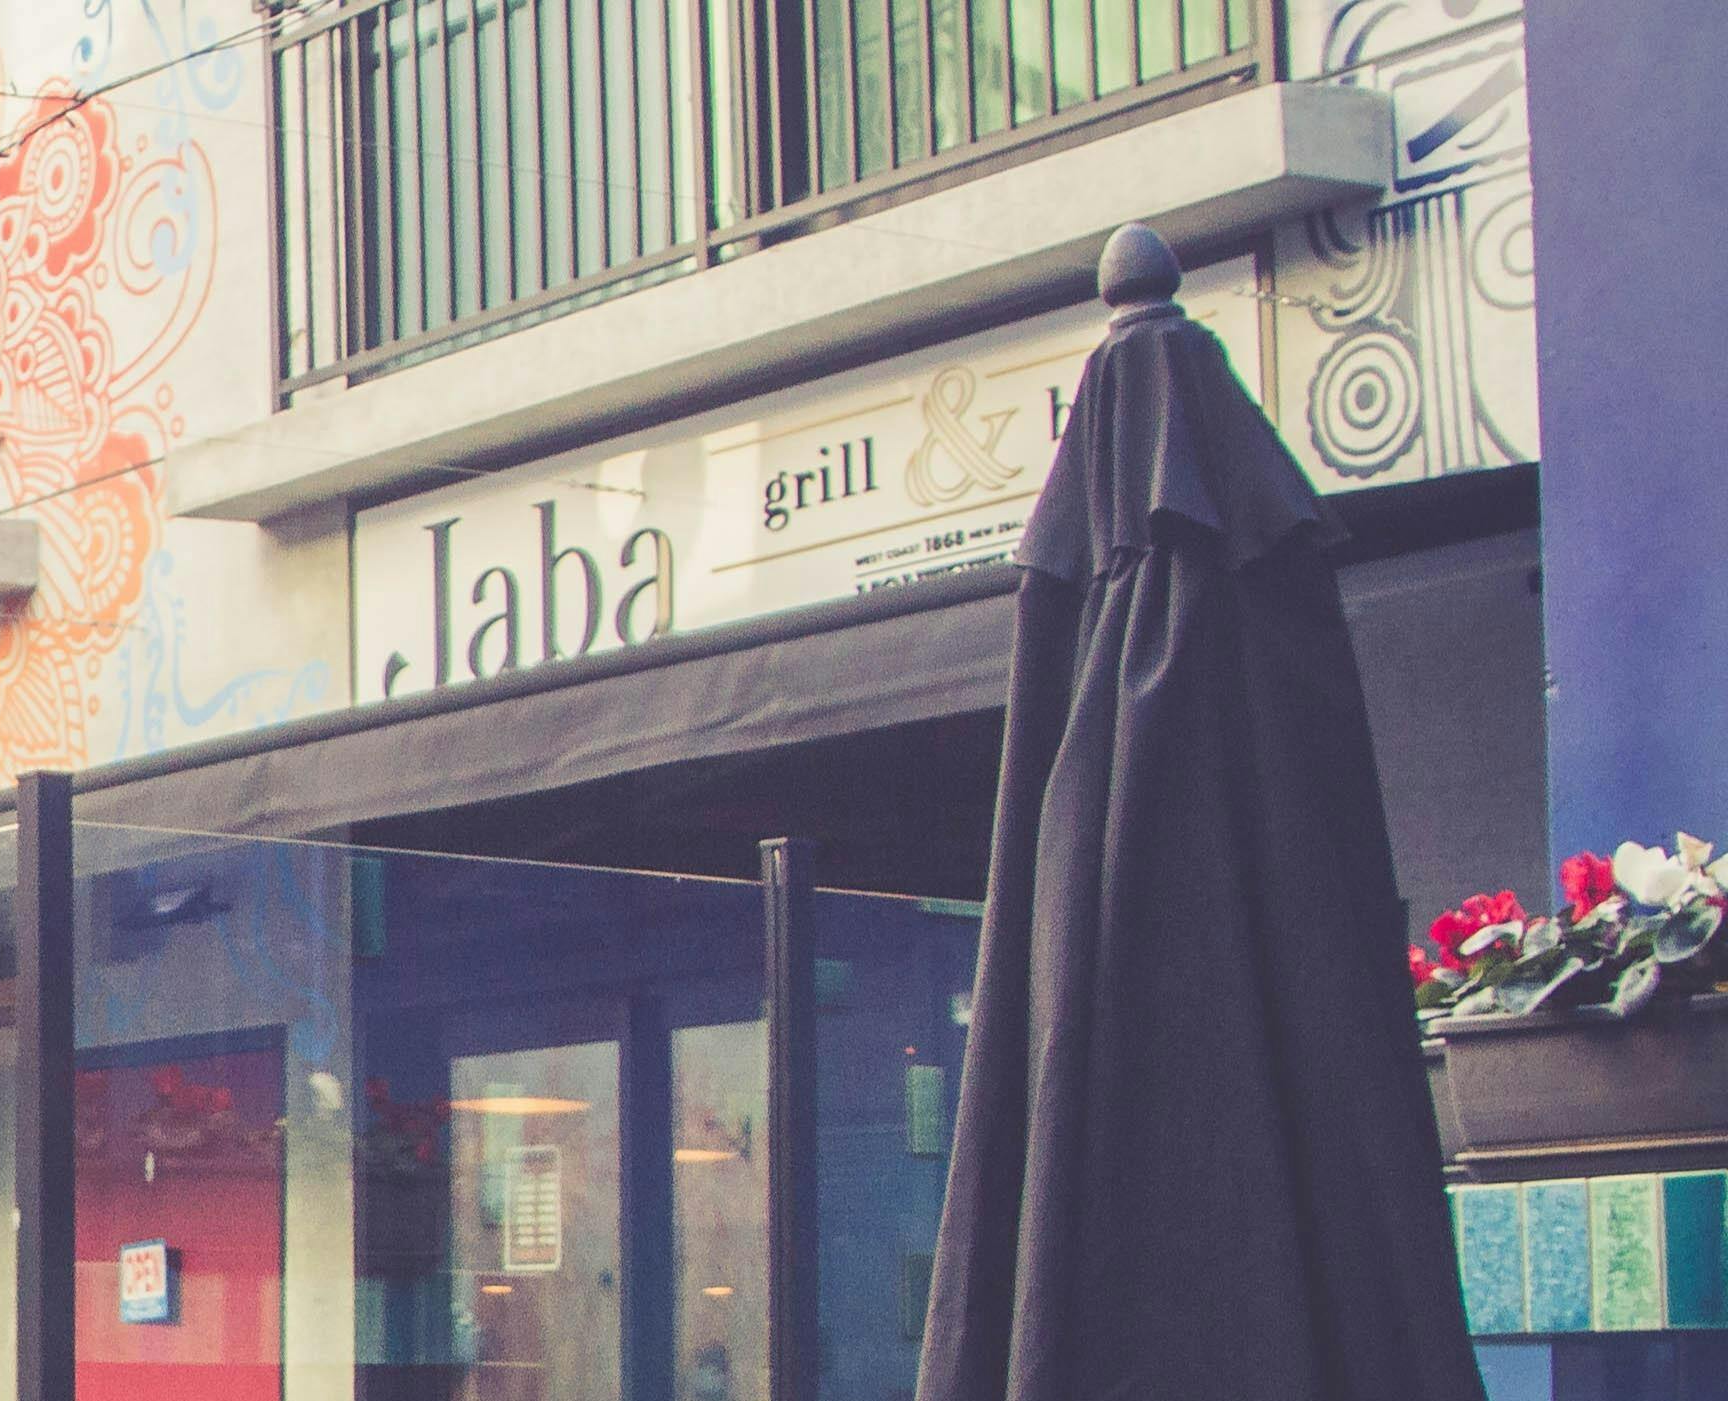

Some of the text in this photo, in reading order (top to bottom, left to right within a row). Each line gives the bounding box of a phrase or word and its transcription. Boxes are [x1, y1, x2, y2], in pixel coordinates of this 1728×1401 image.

[763, 436, 878, 532] grill
[905, 364, 1024, 507] &
[382, 499, 674, 699] Jaba
[924, 529, 965, 553] 1868
